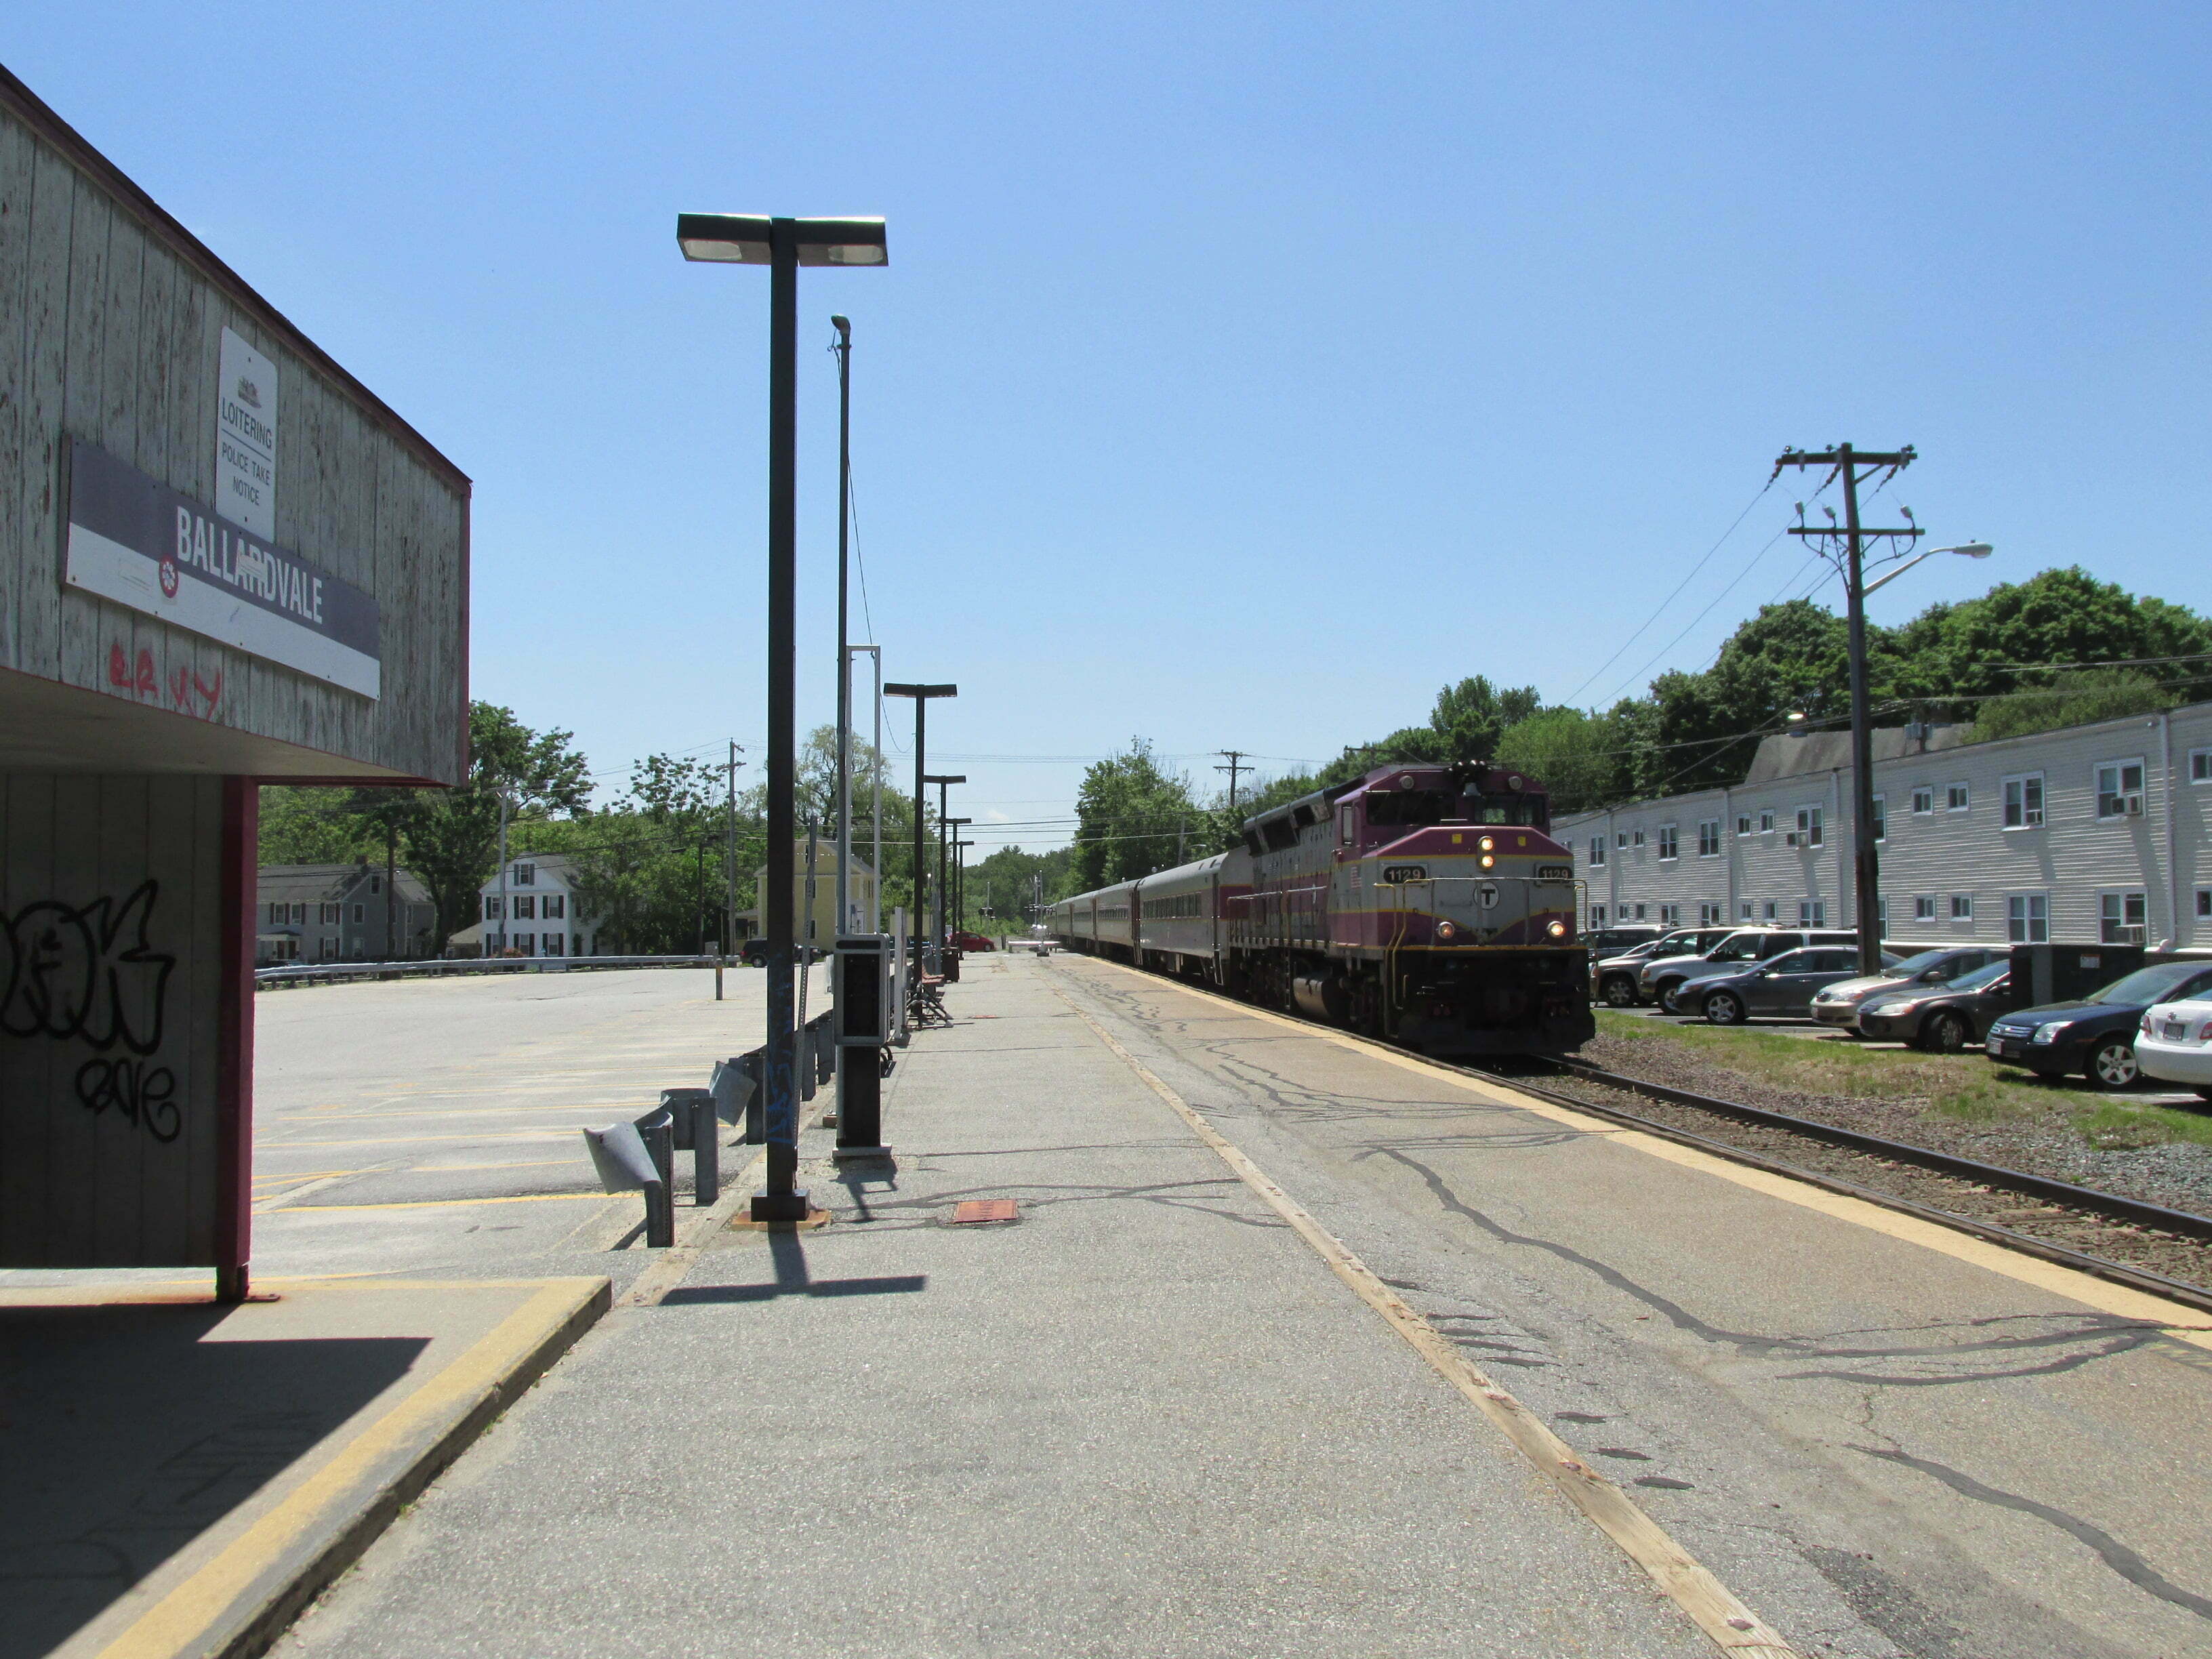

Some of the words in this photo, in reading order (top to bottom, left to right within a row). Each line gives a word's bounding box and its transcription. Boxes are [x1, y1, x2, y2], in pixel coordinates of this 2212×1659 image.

[222, 397, 272, 449] LOITERING
[222, 441, 249, 474] POLICE
[251, 460, 270, 486] TAKE
[233, 476, 260, 506] NOTICE
[1389, 869, 1421, 880] 1129
[1542, 868, 1568, 880] 1129
[1481, 888, 1496, 905] T
